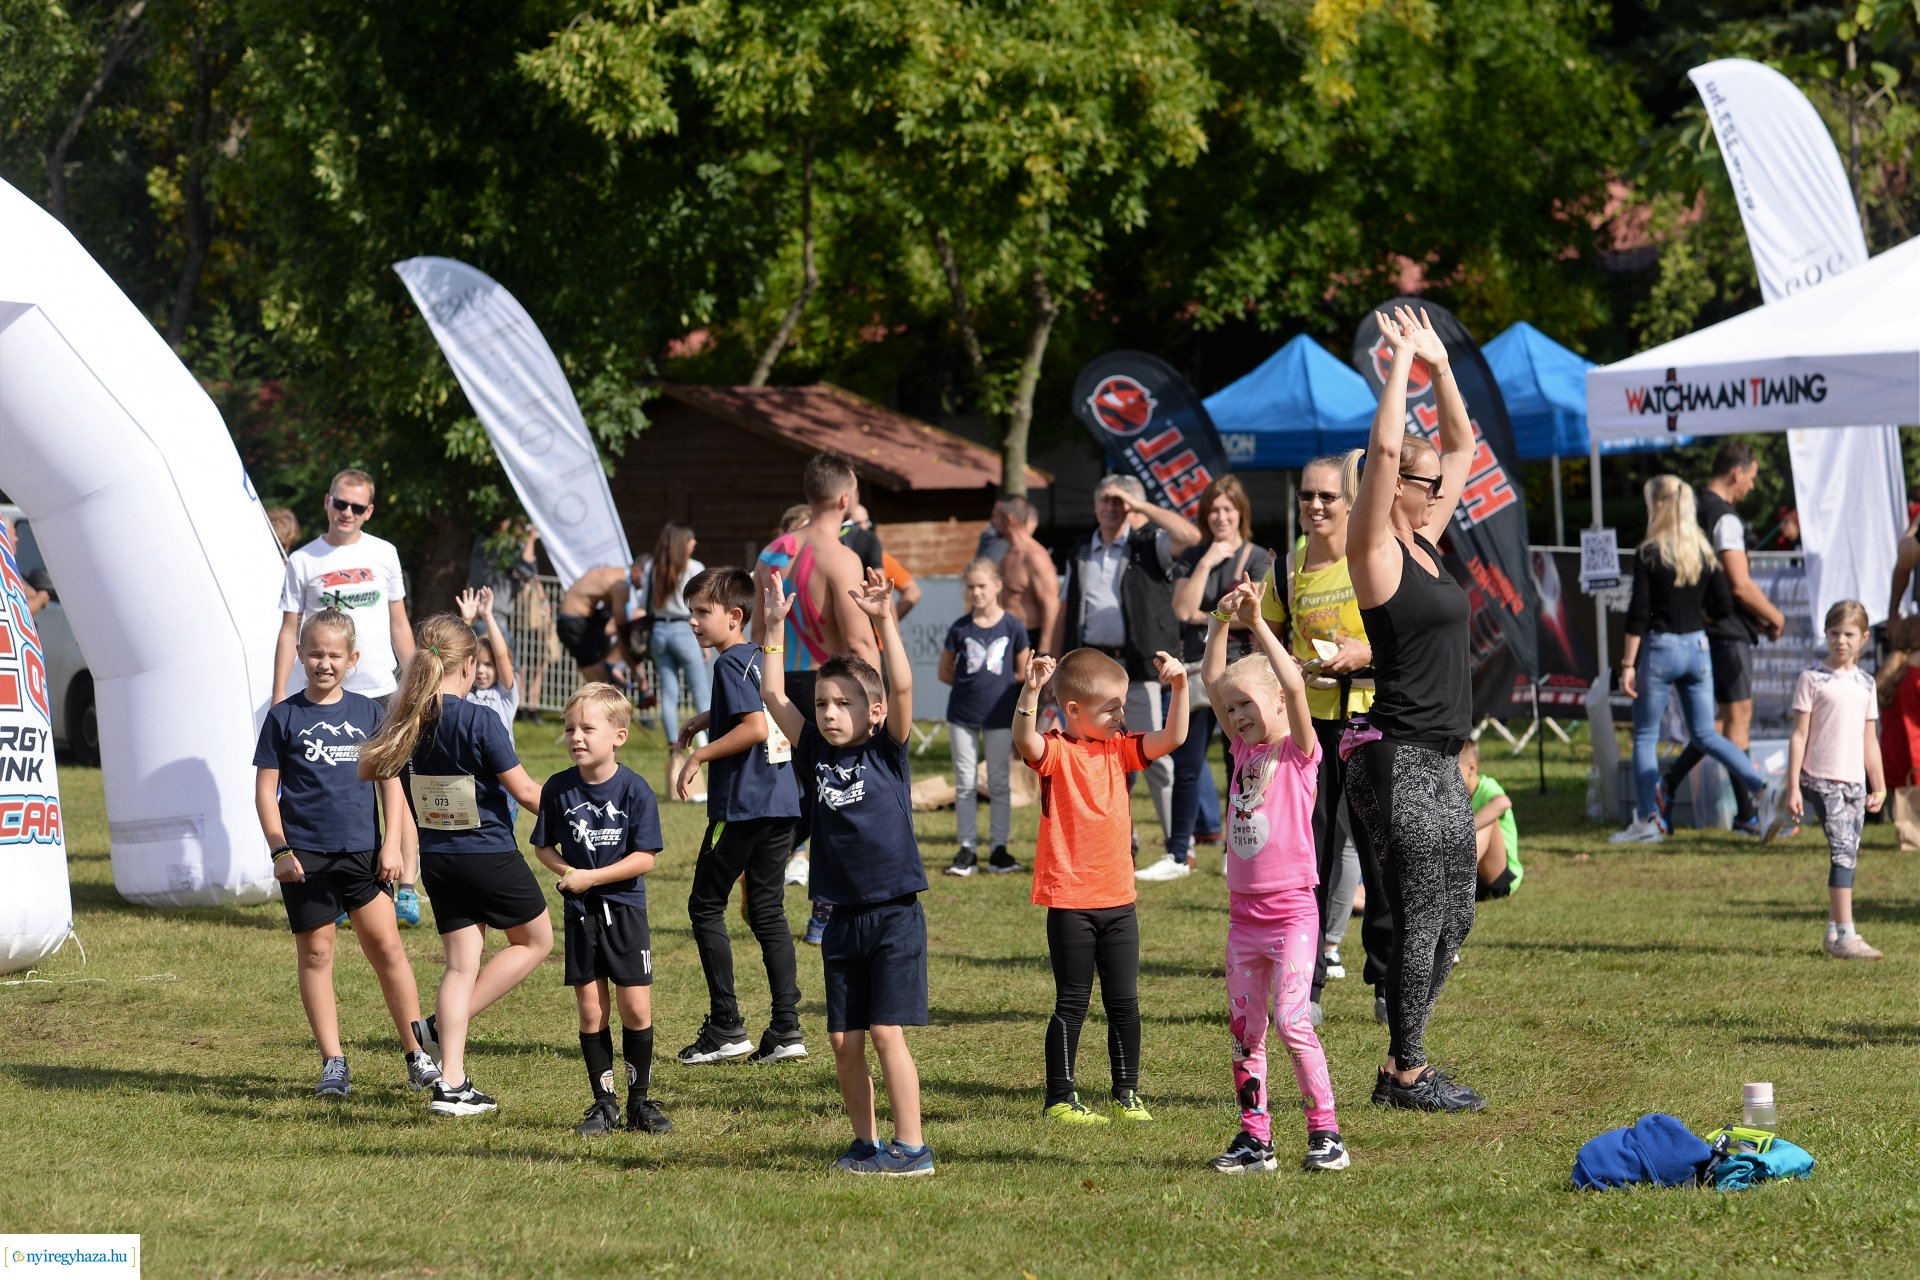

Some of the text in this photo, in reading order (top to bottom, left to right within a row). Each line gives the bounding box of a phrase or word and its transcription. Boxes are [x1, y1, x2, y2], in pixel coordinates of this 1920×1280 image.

[1625, 373, 1828, 416] WATCHMAN TIMING
[434, 798, 449, 806] 073
